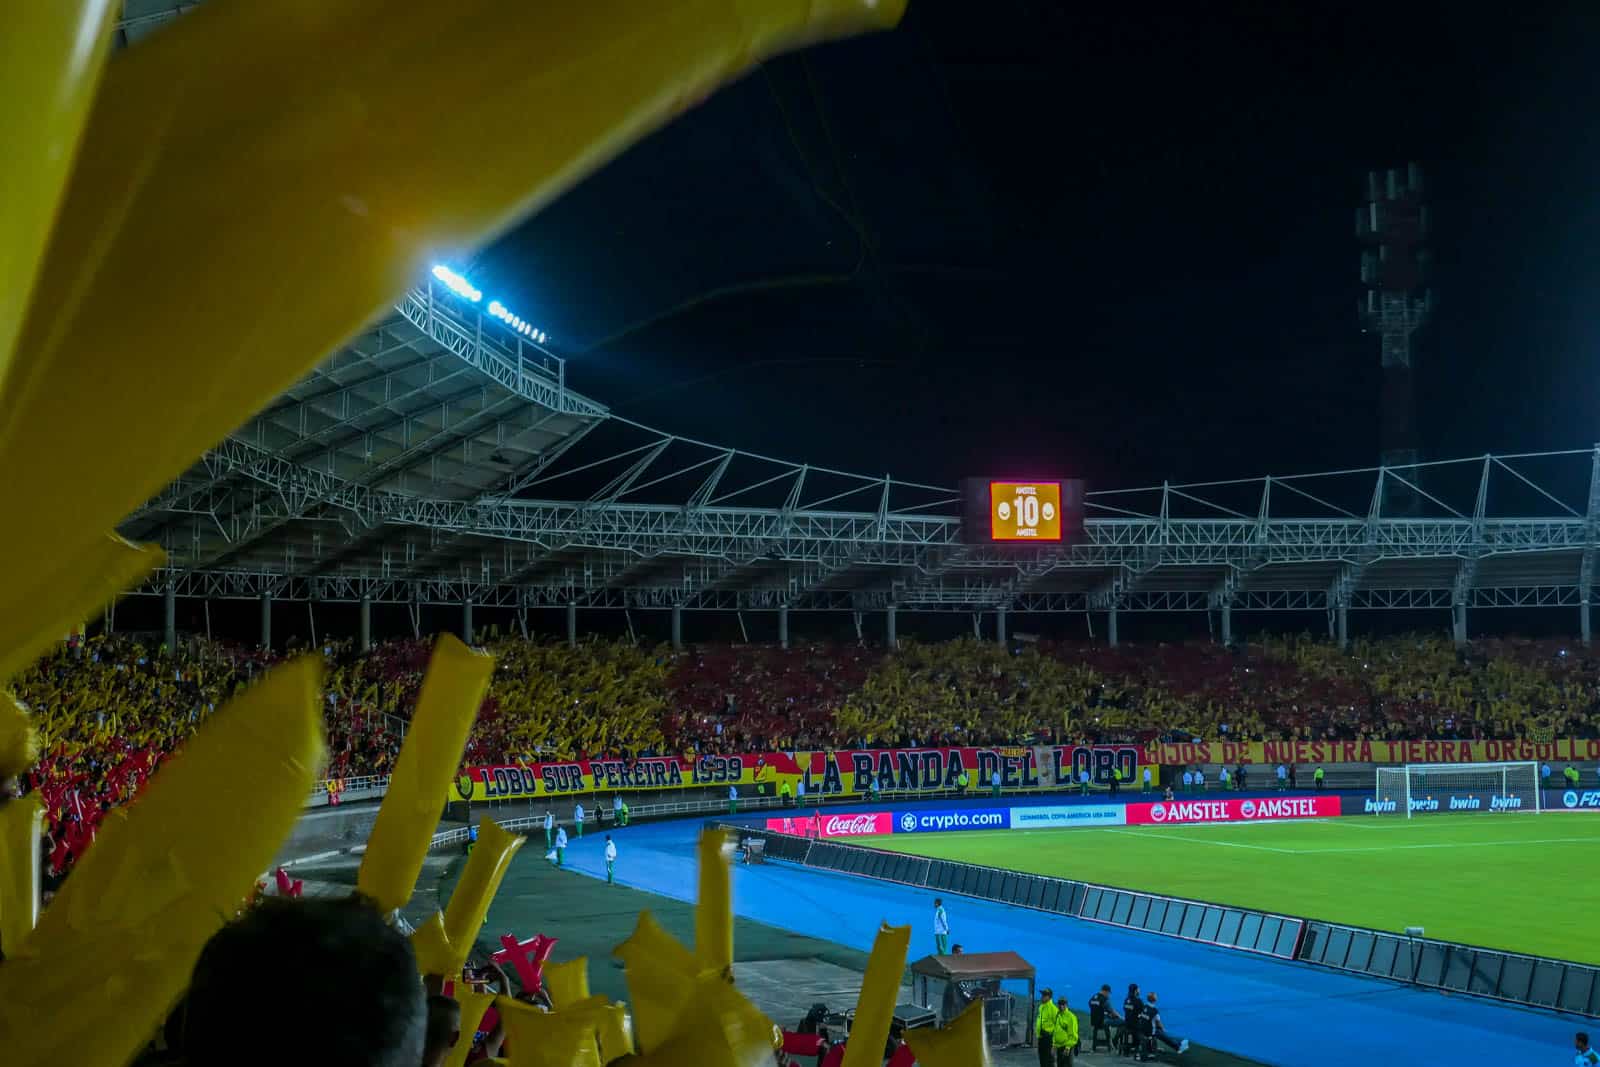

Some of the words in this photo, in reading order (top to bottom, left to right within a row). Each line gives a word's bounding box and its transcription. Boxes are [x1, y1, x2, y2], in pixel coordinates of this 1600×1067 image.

[1013, 495, 1039, 527] 10
[1222, 741, 1253, 764] DE
[1263, 740, 1373, 763] NUESTRA
[1386, 739, 1473, 763] TIERRA
[480, 767, 536, 797] LOBO
[541, 764, 584, 792] SUR
[589, 759, 683, 788] PEREIRA
[801, 750, 843, 794] LA
[851, 750, 967, 792] BANDA
[976, 750, 1039, 789] DEL
[1054, 747, 1139, 785] LOBO
[1258, 799, 1317, 817] AMSTEL
[1364, 797, 1396, 812] bwin
[1408, 796, 1439, 810] bwin
[1449, 795, 1480, 809] bwin
[1491, 793, 1521, 808] bwin
[1168, 801, 1229, 820] AMSTEL
[826, 815, 876, 835] Coca-Cola
[921, 812, 1002, 828] crypto.com
